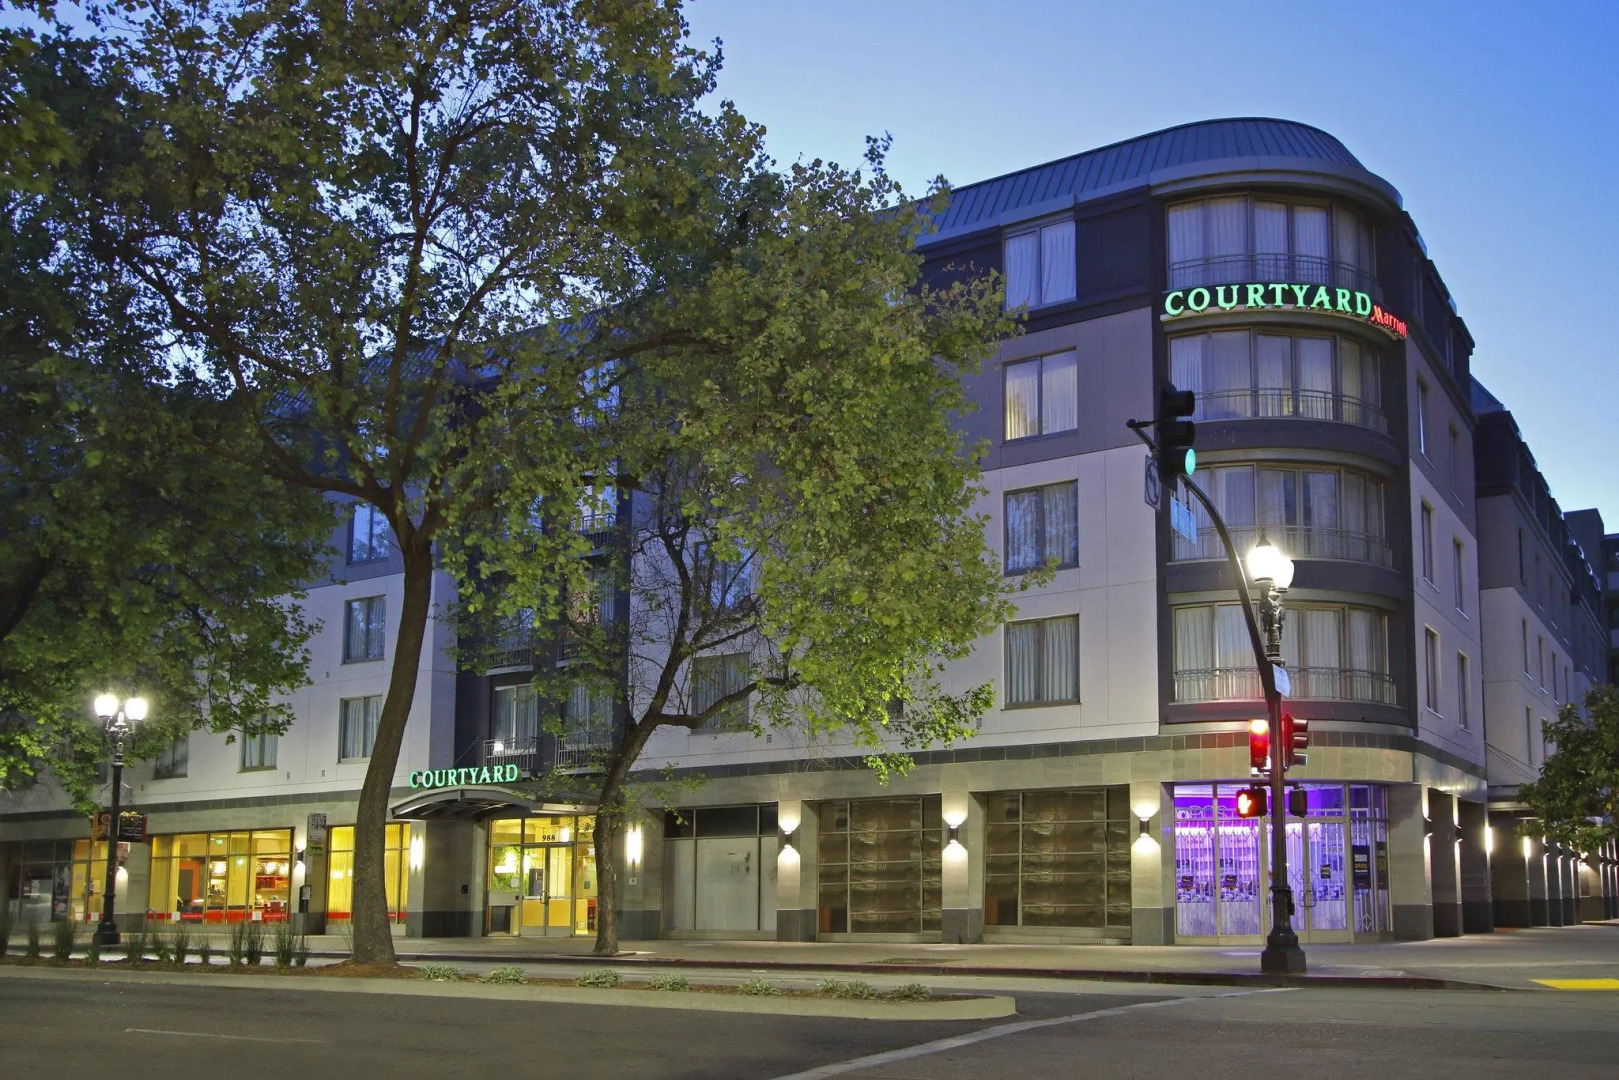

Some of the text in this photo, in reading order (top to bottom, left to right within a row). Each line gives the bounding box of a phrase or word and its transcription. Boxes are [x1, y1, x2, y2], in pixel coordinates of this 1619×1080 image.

[1165, 283, 1408, 339] COURTYARD Marriott
[409, 764, 518, 788] COURTYARD
[542, 834, 556, 842] 988
